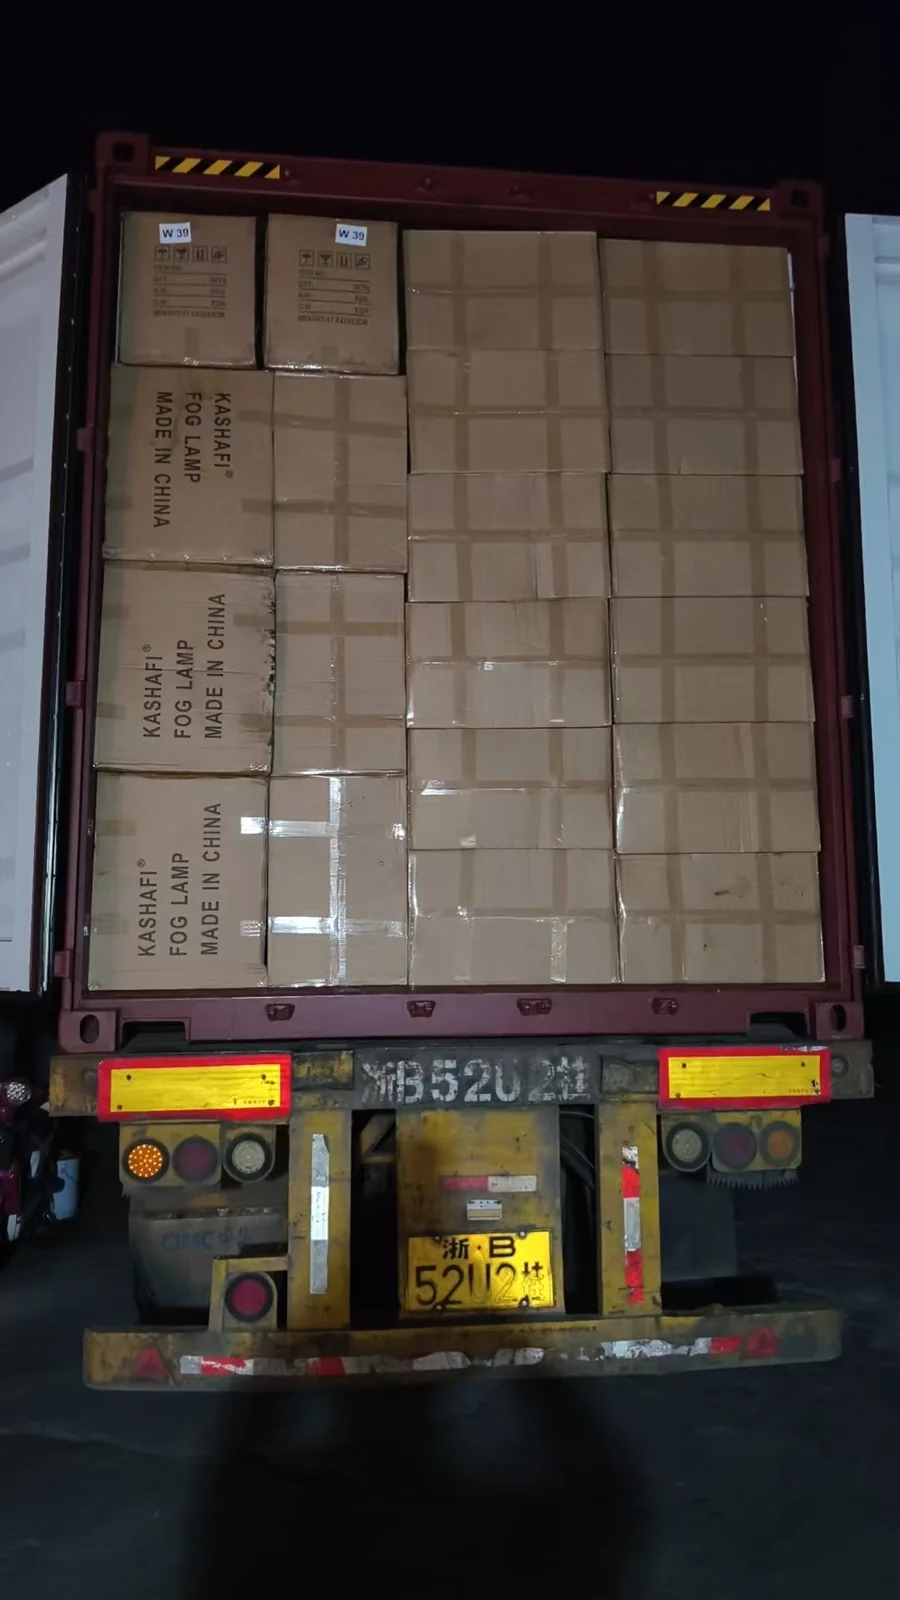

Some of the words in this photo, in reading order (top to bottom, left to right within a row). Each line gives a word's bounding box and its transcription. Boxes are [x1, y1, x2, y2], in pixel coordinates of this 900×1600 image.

[162, 228, 174, 238] W
[176, 228, 190, 238] 39
[338, 229, 350, 238] W
[352, 231, 365, 241] 39
[155, 391, 173, 439] MADE
[184, 392, 202, 426] FOG
[154, 448, 172, 464] IN
[184, 435, 202, 483] LAMP
[153, 473, 172, 528] CHINA
[207, 593, 226, 650] CHINA
[175, 639, 194, 690] LAMP
[206, 660, 224, 677] IN
[174, 699, 193, 739] FOG
[204, 687, 223, 739] MADE
[202, 803, 221, 862] CHINA
[171, 852, 189, 905] LAMP
[202, 873, 220, 890] IN
[169, 916, 188, 956] FOG
[200, 900, 219, 955] MADE
